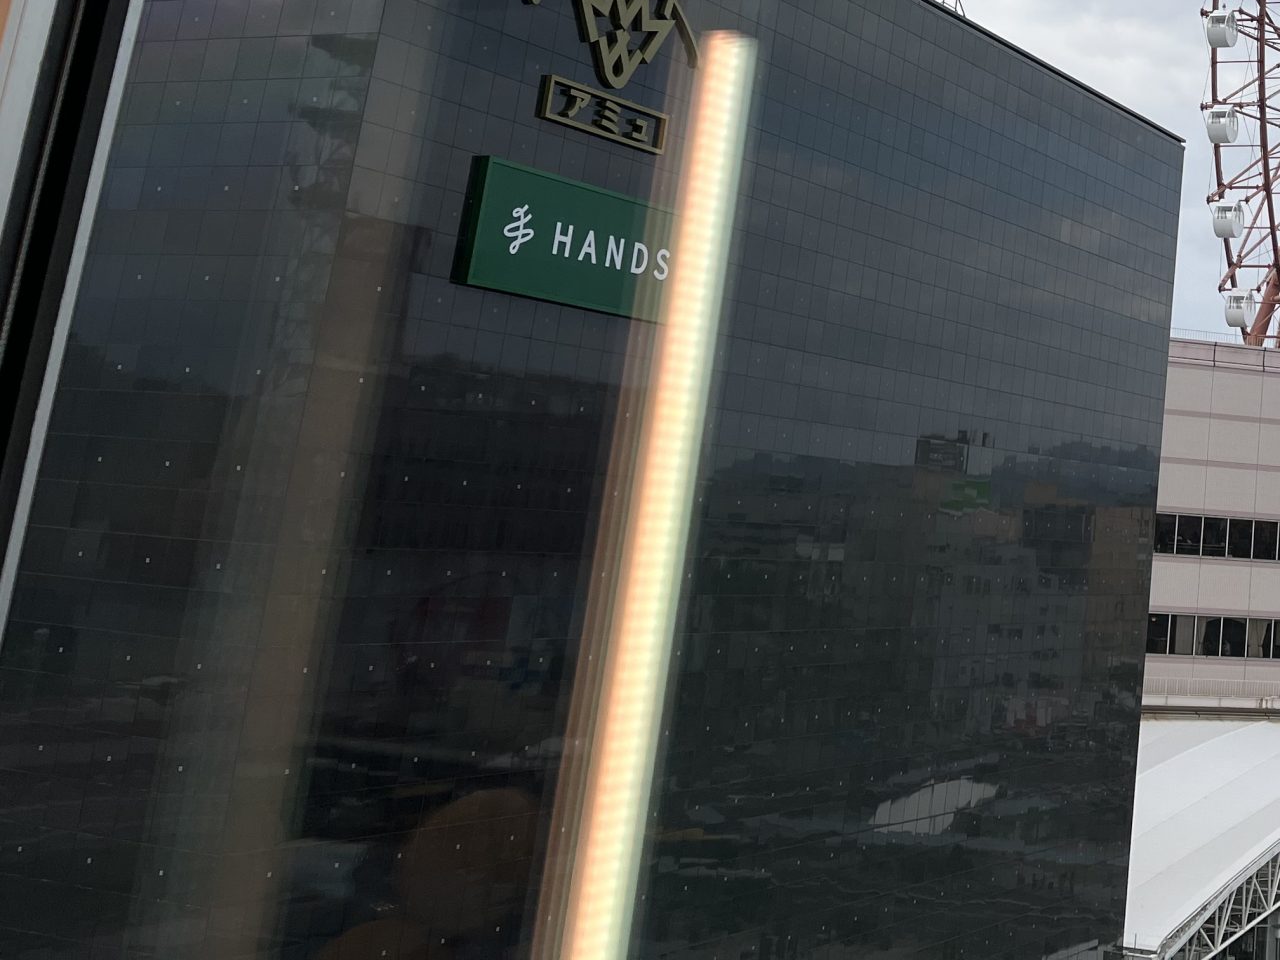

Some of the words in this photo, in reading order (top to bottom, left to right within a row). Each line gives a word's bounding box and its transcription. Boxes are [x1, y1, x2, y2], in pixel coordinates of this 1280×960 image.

[557, 86, 650, 142] アミュ
[551, 221, 671, 281] HANDS
